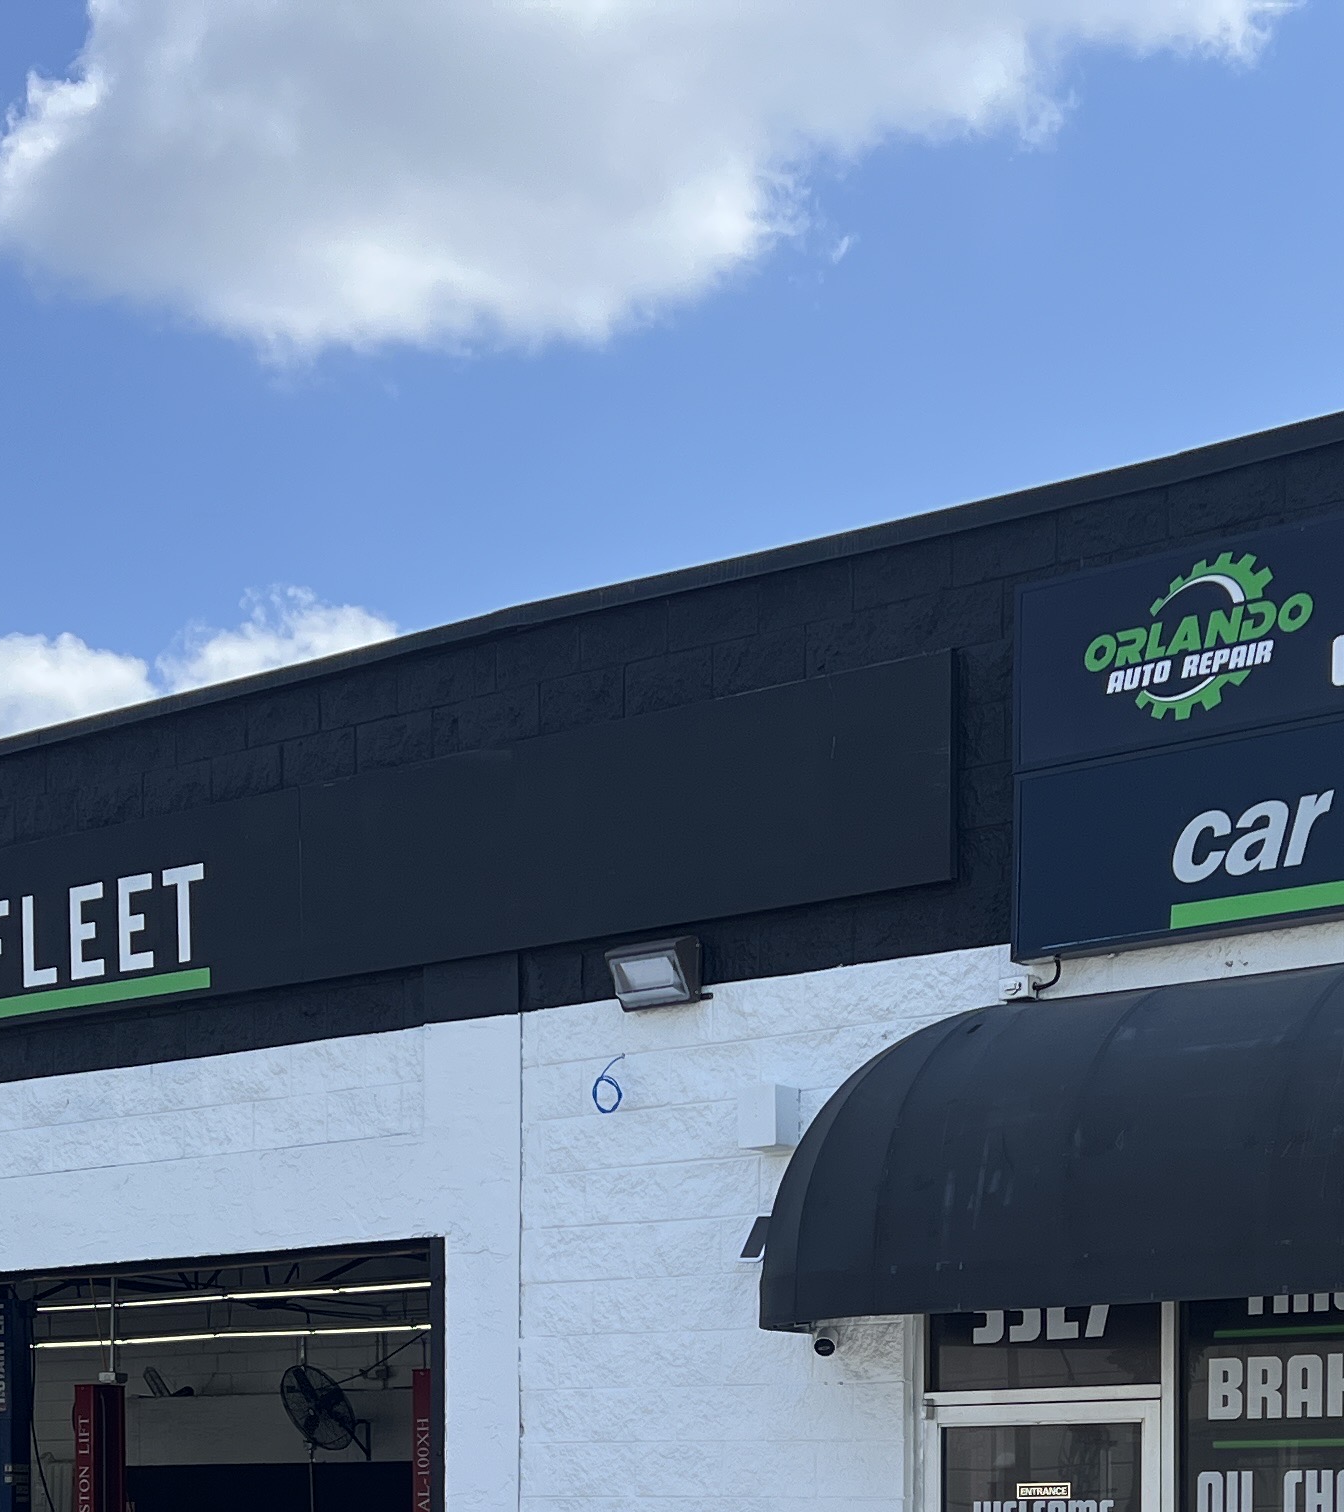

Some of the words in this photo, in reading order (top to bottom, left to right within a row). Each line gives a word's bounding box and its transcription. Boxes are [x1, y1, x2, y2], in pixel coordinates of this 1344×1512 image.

[1084, 592, 1314, 673] ORLANDO
[1106, 659, 1172, 695] AUTO
[1181, 639, 1274, 680] REPAIR
[1172, 788, 1332, 884] car
[78, 1415, 90, 1455] LIFT
[417, 1418, 430, 1512] AL-100XH
[1020, 1486, 1068, 1496] ENTRANCE
